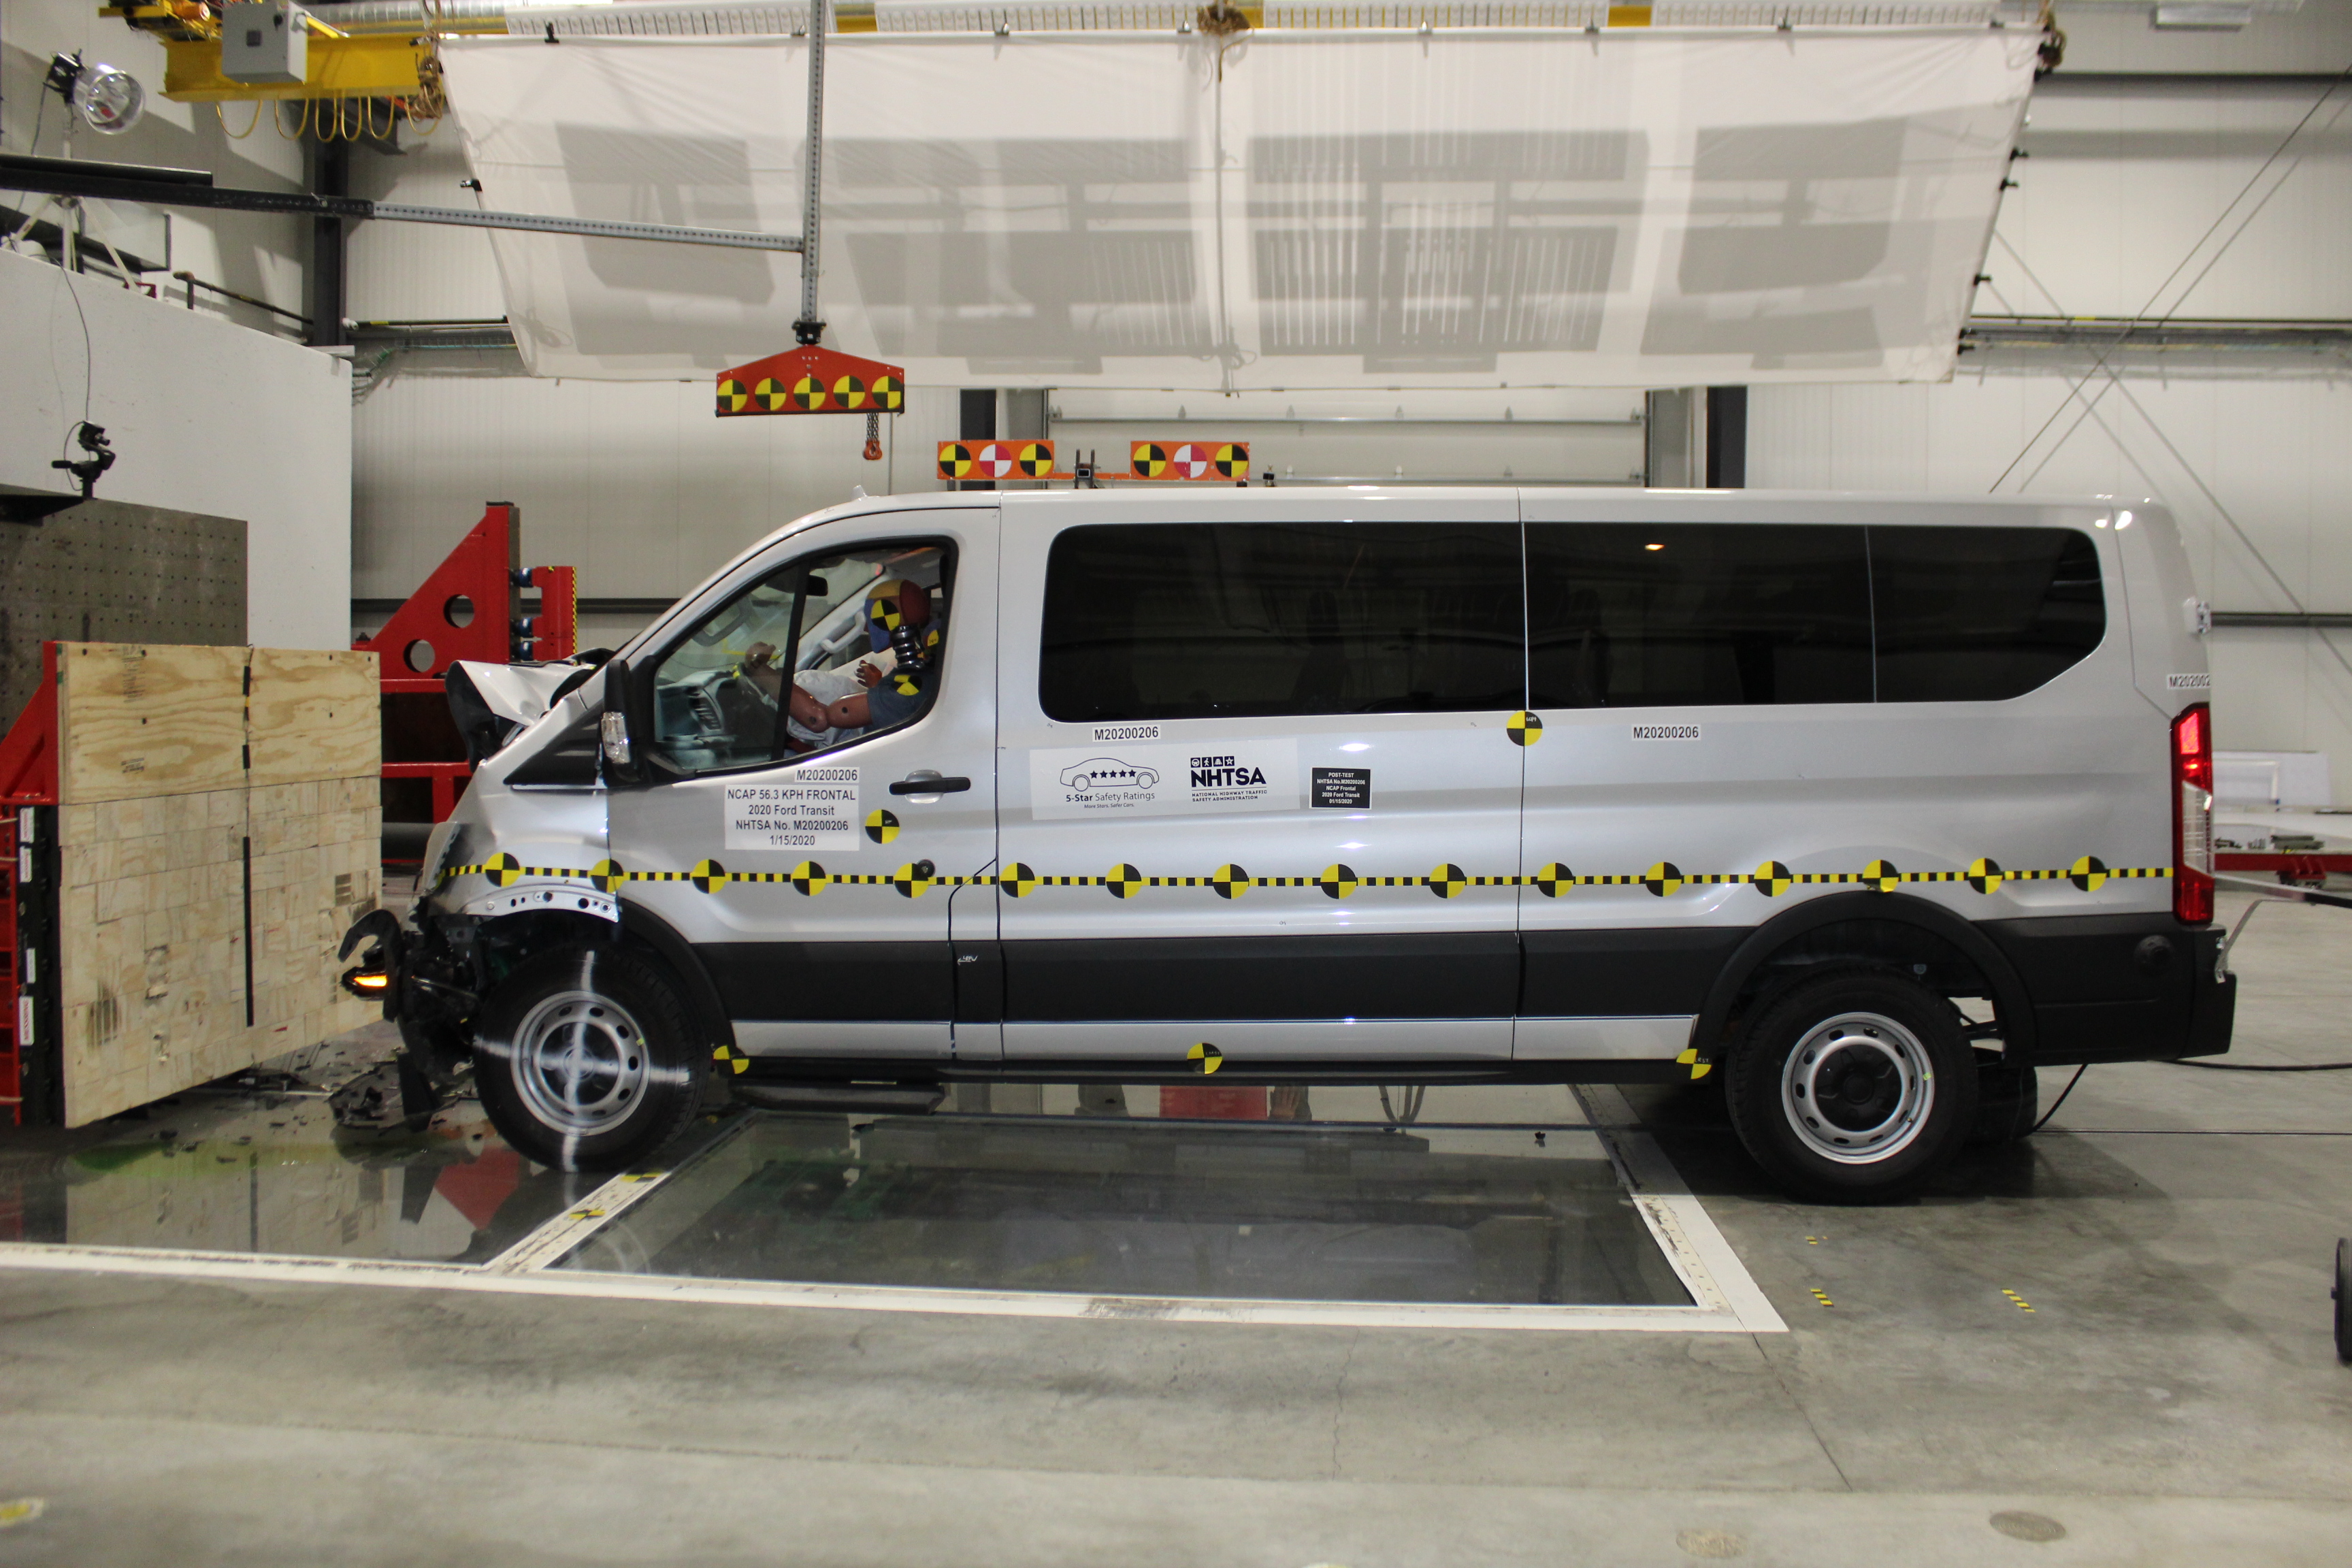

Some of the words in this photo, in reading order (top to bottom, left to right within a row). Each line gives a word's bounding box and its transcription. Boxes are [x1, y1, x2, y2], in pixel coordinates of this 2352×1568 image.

[1094, 726, 1159, 740] M20200206
[1633, 726, 1699, 738] M20200206
[796, 769, 858, 781] M20200206
[1190, 767, 1267, 787] NHTSA
[728, 789, 756, 800] NCAP
[759, 789, 779, 800] 56.3
[782, 789, 803, 800] KPH
[806, 789, 856, 800] FRONTAL
[1095, 792, 1122, 802] Safety
[1124, 791, 1155, 801] Ratings
[748, 804, 771, 815] 2020
[774, 804, 797, 815] Ford
[800, 804, 835, 816] Transit
[736, 819, 772, 830] NHTSA
[774, 820, 791, 830] No.
[794, 820, 849, 831] M20200206
[770, 834, 815, 846] 1/15/2020
